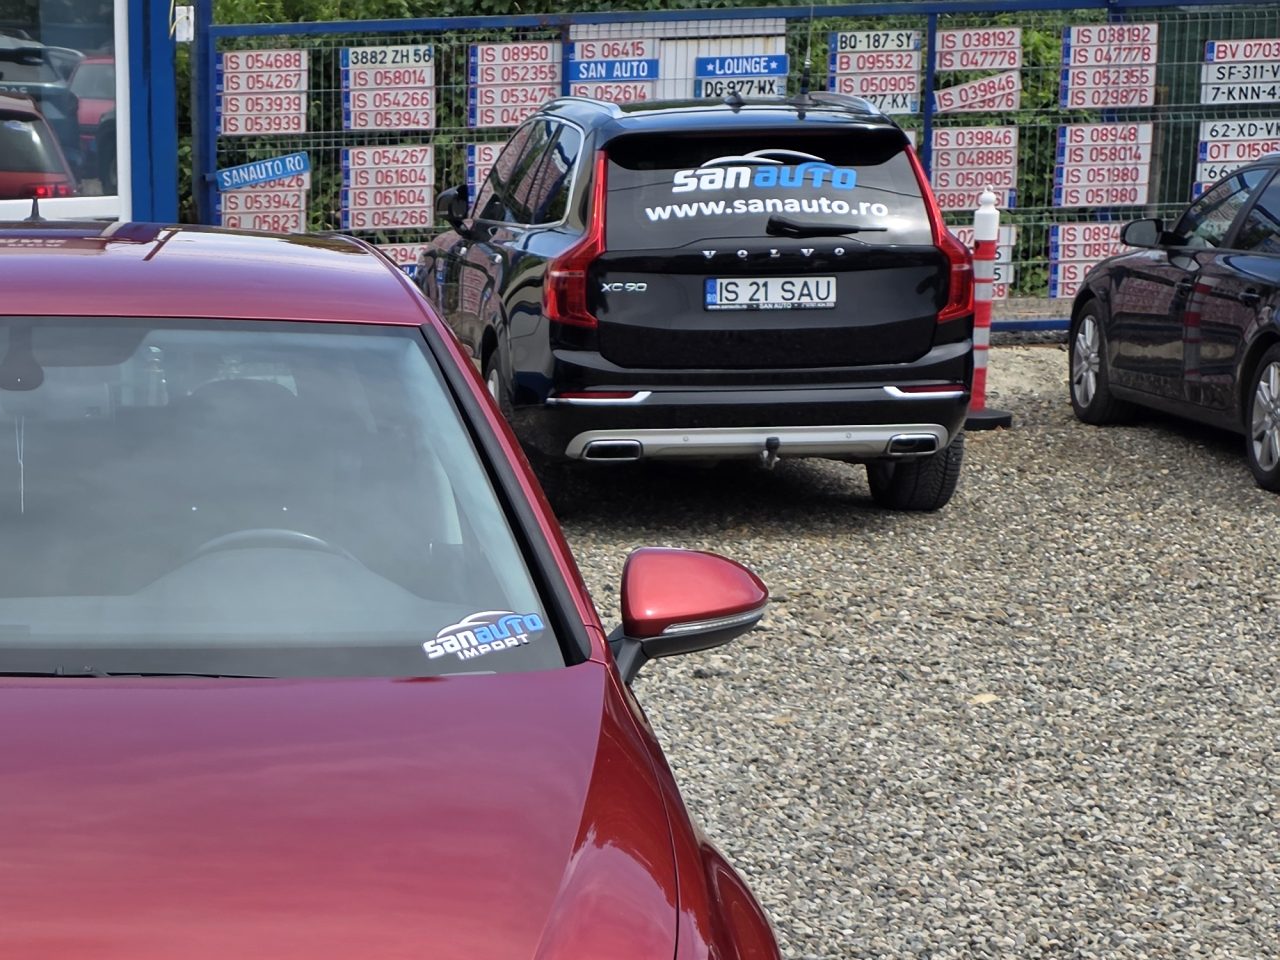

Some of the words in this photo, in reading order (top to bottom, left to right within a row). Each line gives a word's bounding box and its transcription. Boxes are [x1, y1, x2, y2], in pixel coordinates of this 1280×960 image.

[941, 34, 957, 49] IS
[962, 31, 1015, 48] 038192
[1077, 29, 1092, 44] IS
[1098, 27, 1150, 43] 038192
[351, 50, 387, 64] 3882
[391, 49, 409, 63] ZH
[481, 47, 496, 62] IS
[502, 46, 548, 62] 08950
[581, 43, 595, 59] IS
[602, 41, 644, 57] 06415
[1073, 48, 1088, 64] IS
[1094, 47, 1151, 63] 047778
[1216, 44, 1239, 59] BV
[225, 55, 240, 70] IS
[246, 53, 301, 69] 054688
[715, 57, 769, 74] LOUNGE
[840, 55, 851, 71] B
[856, 53, 913, 70] 095532
[939, 52, 954, 68] IS
[960, 51, 1016, 67] 047778
[353, 71, 368, 86] IS
[374, 69, 425, 86] 058014
[481, 67, 495, 82] IS
[501, 65, 557, 82] 052355
[579, 62, 606, 78] SAN
[613, 61, 648, 77] AUTO
[1072, 71, 1087, 86] IS
[1092, 69, 1149, 85] 052355
[226, 75, 240, 90] IS
[246, 73, 301, 90] 054267
[839, 78, 854, 93] IS
[860, 76, 915, 93] 050905
[480, 90, 495, 104] IS
[574, 86, 588, 96] IS
[1071, 90, 1086, 106] IS
[1092, 88, 1148, 105] 029876
[1212, 85, 1280, 101] 7-KNN-4
[225, 97, 240, 112] IS
[245, 96, 301, 112] 053939
[352, 93, 367, 108] IS
[373, 92, 429, 108] 054266
[938, 92, 954, 108] IS
[223, 117, 239, 132] IS
[245, 115, 301, 131] 053939
[354, 112, 369, 127] IS
[374, 111, 430, 127] 053943
[480, 109, 495, 124] IS
[935, 131, 950, 147] IS
[956, 130, 1012, 146] 039846
[1070, 128, 1085, 144] IS
[1090, 127, 1137, 142] 08948
[352, 151, 367, 166] IS
[372, 149, 428, 165] 054267
[936, 151, 951, 167] IS
[956, 150, 1013, 166] 048885
[1069, 147, 1084, 163] IS
[1089, 145, 1141, 162] 058014
[1209, 144, 1230, 159] OT
[355, 170, 369, 185] IS
[375, 168, 426, 184] 061604
[935, 172, 950, 187] IS
[956, 171, 1011, 187] 050905
[1066, 169, 1081, 183] IS
[1087, 167, 1139, 183] 051980
[224, 194, 239, 210] IS
[245, 194, 300, 209] 053942
[353, 191, 368, 206] IS
[374, 189, 425, 205] 061604
[1065, 189, 1080, 204] IS
[1085, 187, 1138, 204] 051980
[645, 196, 888, 221] www.sanauto.ro
[351, 212, 366, 227] IS
[372, 210, 428, 226] 054266
[1062, 227, 1077, 241] IS
[702, 247, 845, 259] VOLVO
[1062, 244, 1077, 258] IS
[719, 282, 739, 302] IS
[748, 281, 768, 301] 21
[781, 280, 830, 301] SAU
[457, 633, 529, 660] IMPORT
